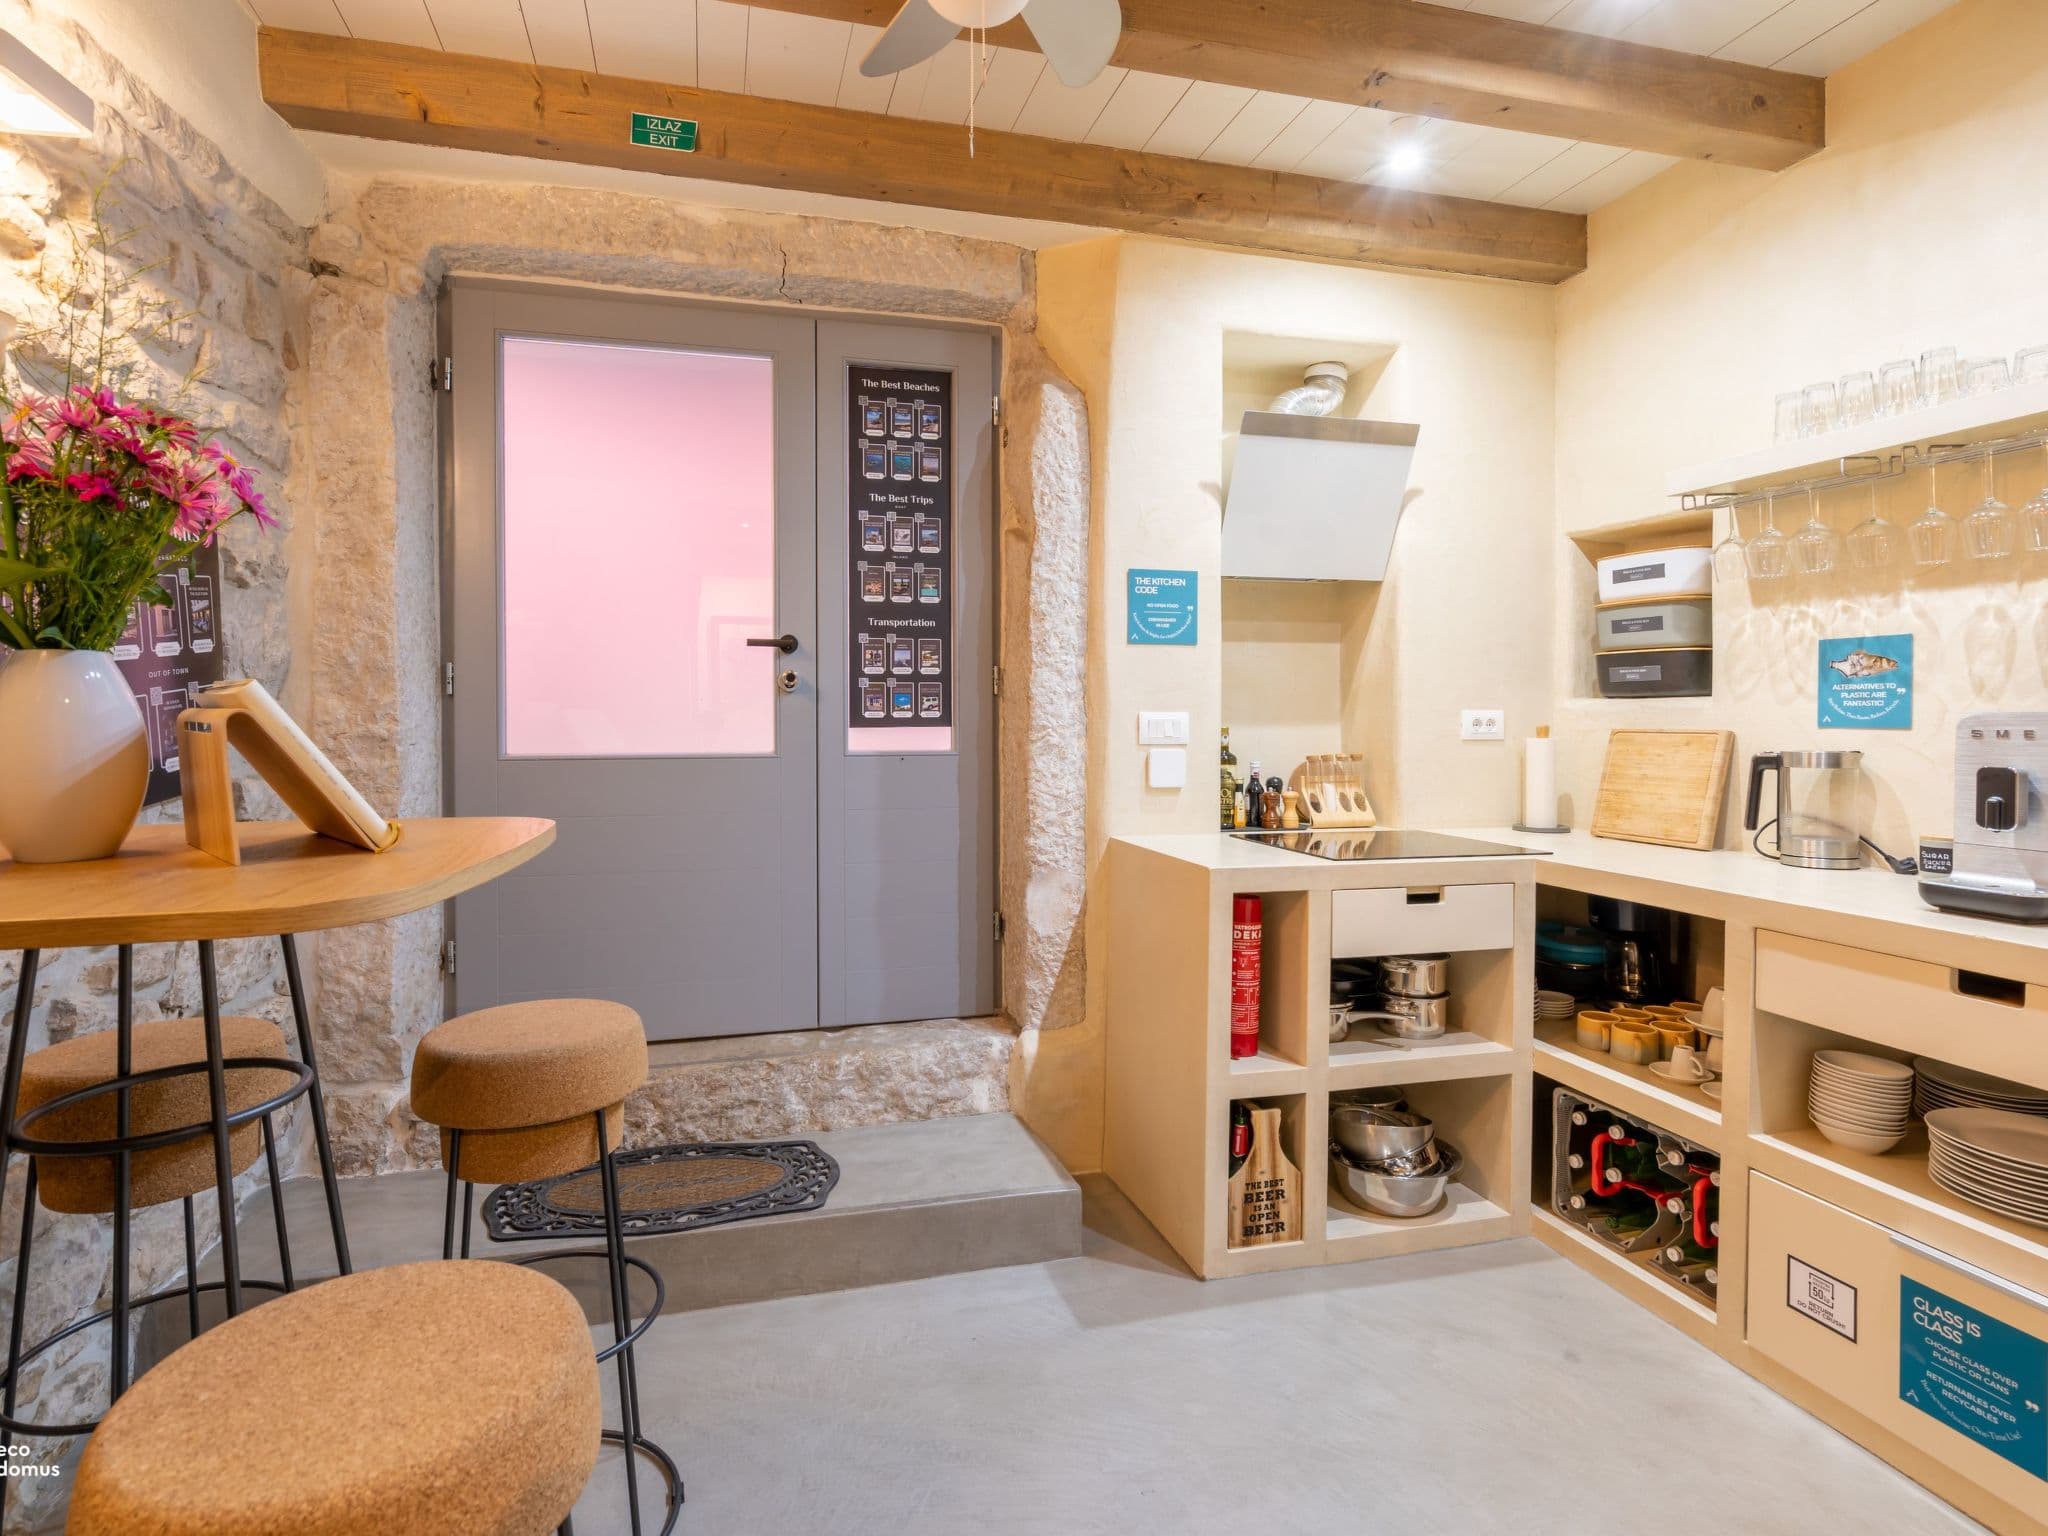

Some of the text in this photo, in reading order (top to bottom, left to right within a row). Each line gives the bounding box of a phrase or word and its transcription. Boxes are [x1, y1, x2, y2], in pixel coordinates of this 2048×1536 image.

[646, 118, 682, 133] IZLAZ
[650, 133, 679, 147] EXIT
[861, 378, 940, 392] The Best Beaches
[869, 493, 934, 505] The Best Trips
[1134, 577, 1186, 586] THE KITCHEN
[1134, 586, 1158, 594] CODE
[868, 617, 936, 628] Transportation
[148, 670, 161, 678] OUT
[172, 667, 189, 675] TOWN
[1832, 683, 1884, 691] ALTERNATIVES
[1245, 1178, 1285, 1191] THE BEST
[1243, 1188, 1286, 1204] BEER
[1253, 1202, 1276, 1212] IS AN
[1249, 1210, 1280, 1223] OPEN
[1242, 1221, 1286, 1238] BEER
[1812, 1286, 1824, 1300] 50
[1797, 1300, 1806, 1308] DO
[1808, 1306, 1821, 1315] NOT
[1808, 1301, 1834, 1318] RETURN
[1913, 1296, 1981, 1338] GLASS IS
[1913, 1311, 1963, 1345] CLASS
[1924, 1337, 2019, 1390] CHOOSE GLASS OVER
[1932, 1350, 2010, 1395] PLASTIC OR CANS
[1926, 1370, 2017, 1424] RETURNABLES OVER
[1942, 1388, 1999, 1425] RECYCABLES
